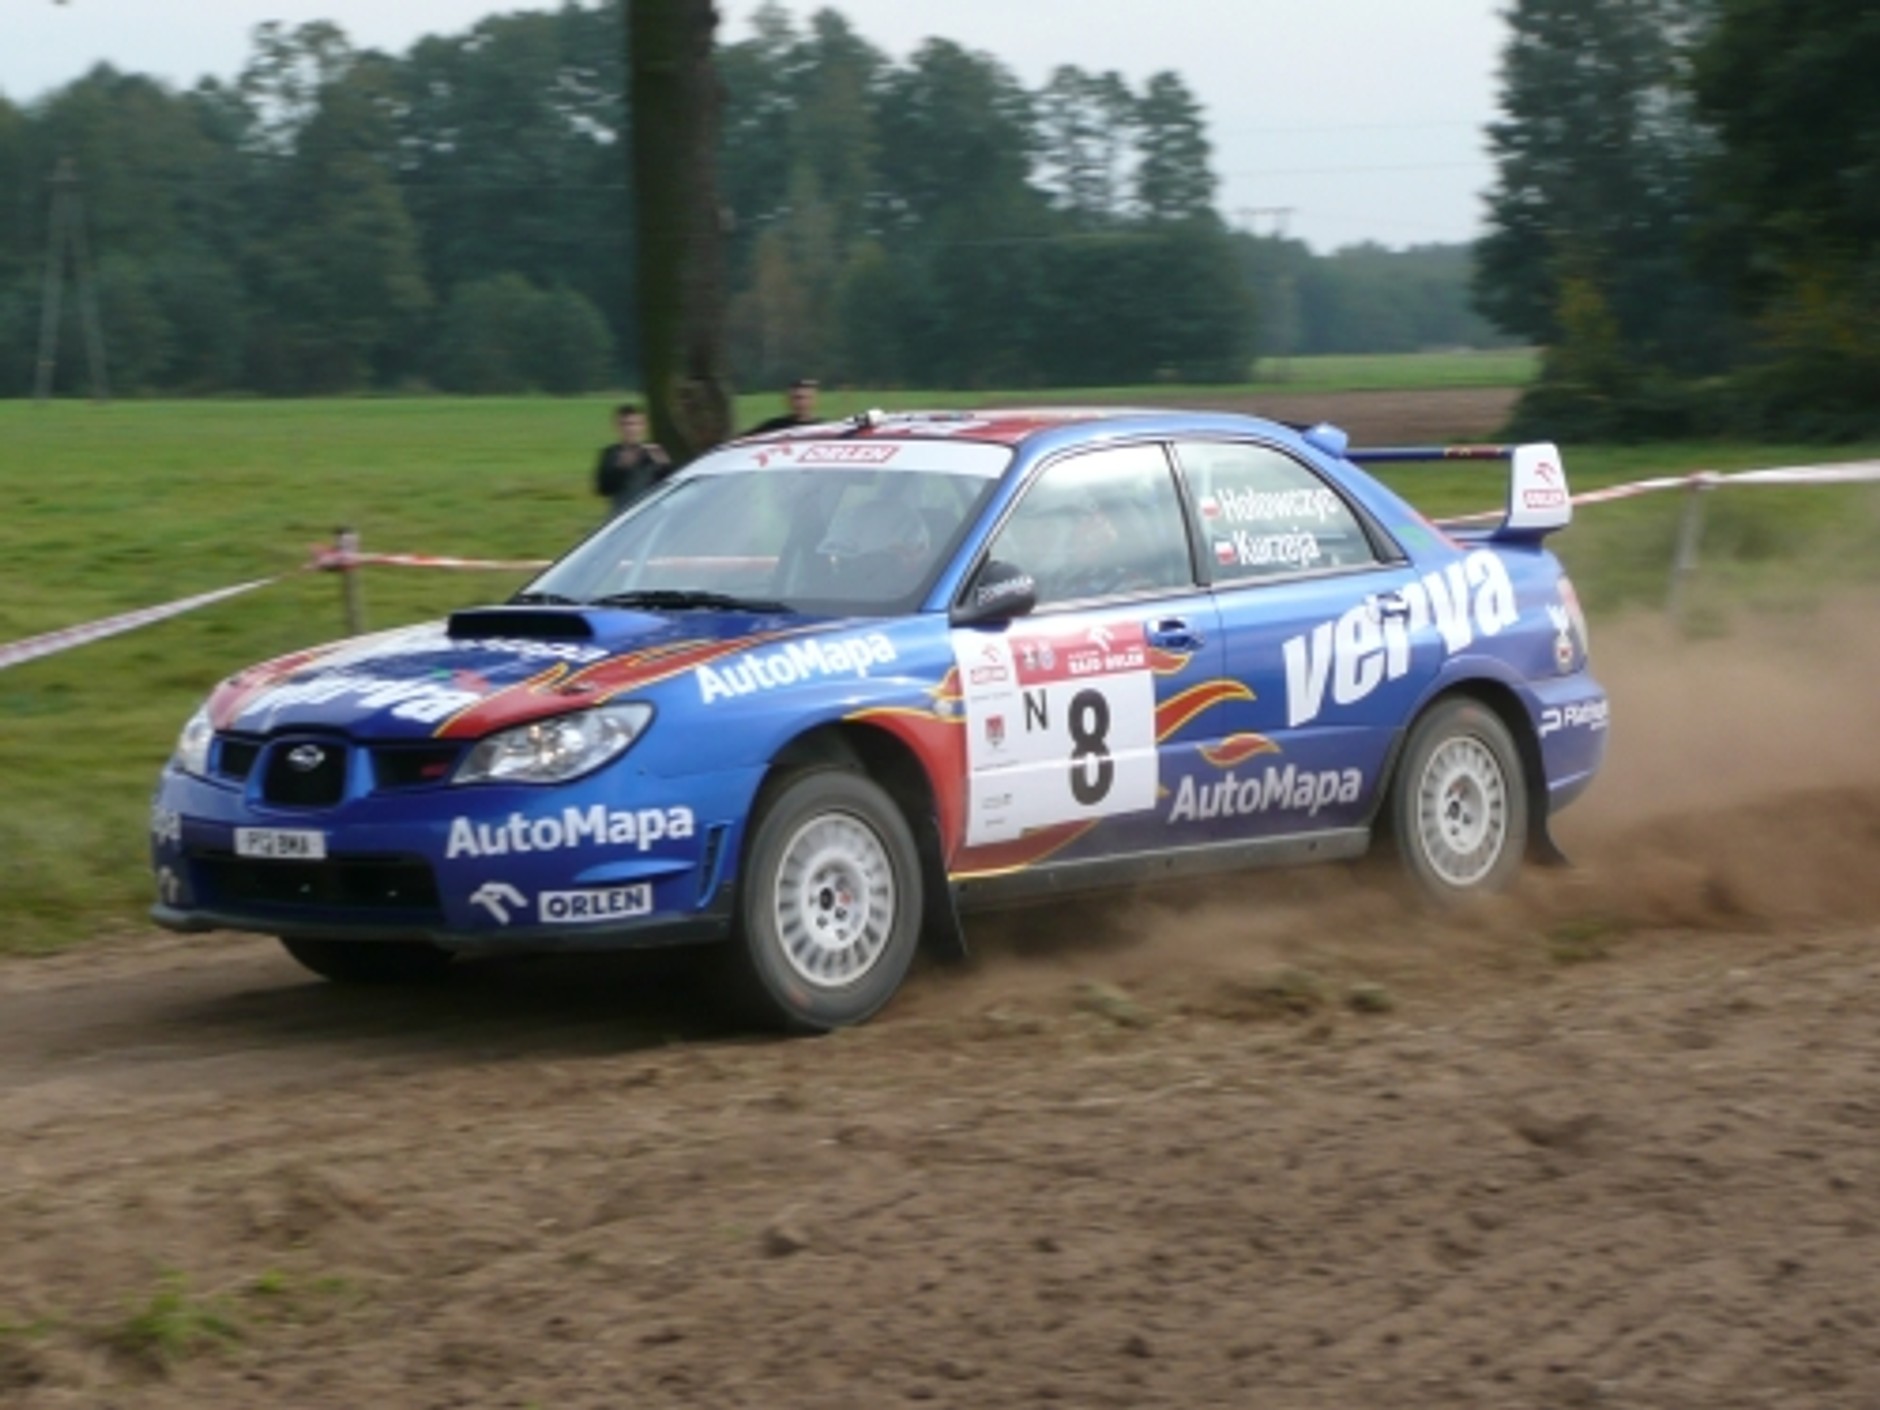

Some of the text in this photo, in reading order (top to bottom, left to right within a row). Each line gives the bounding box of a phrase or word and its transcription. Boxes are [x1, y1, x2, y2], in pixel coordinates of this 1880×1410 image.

[696, 634, 897, 703] AutoMapa
[1283, 549, 1519, 727] verva
[1023, 689, 1048, 731] N
[1068, 688, 1114, 805] 8
[1168, 763, 1363, 824] AutoMapa
[446, 804, 695, 859] AutoMapa
[548, 887, 645, 919] ORLEN
